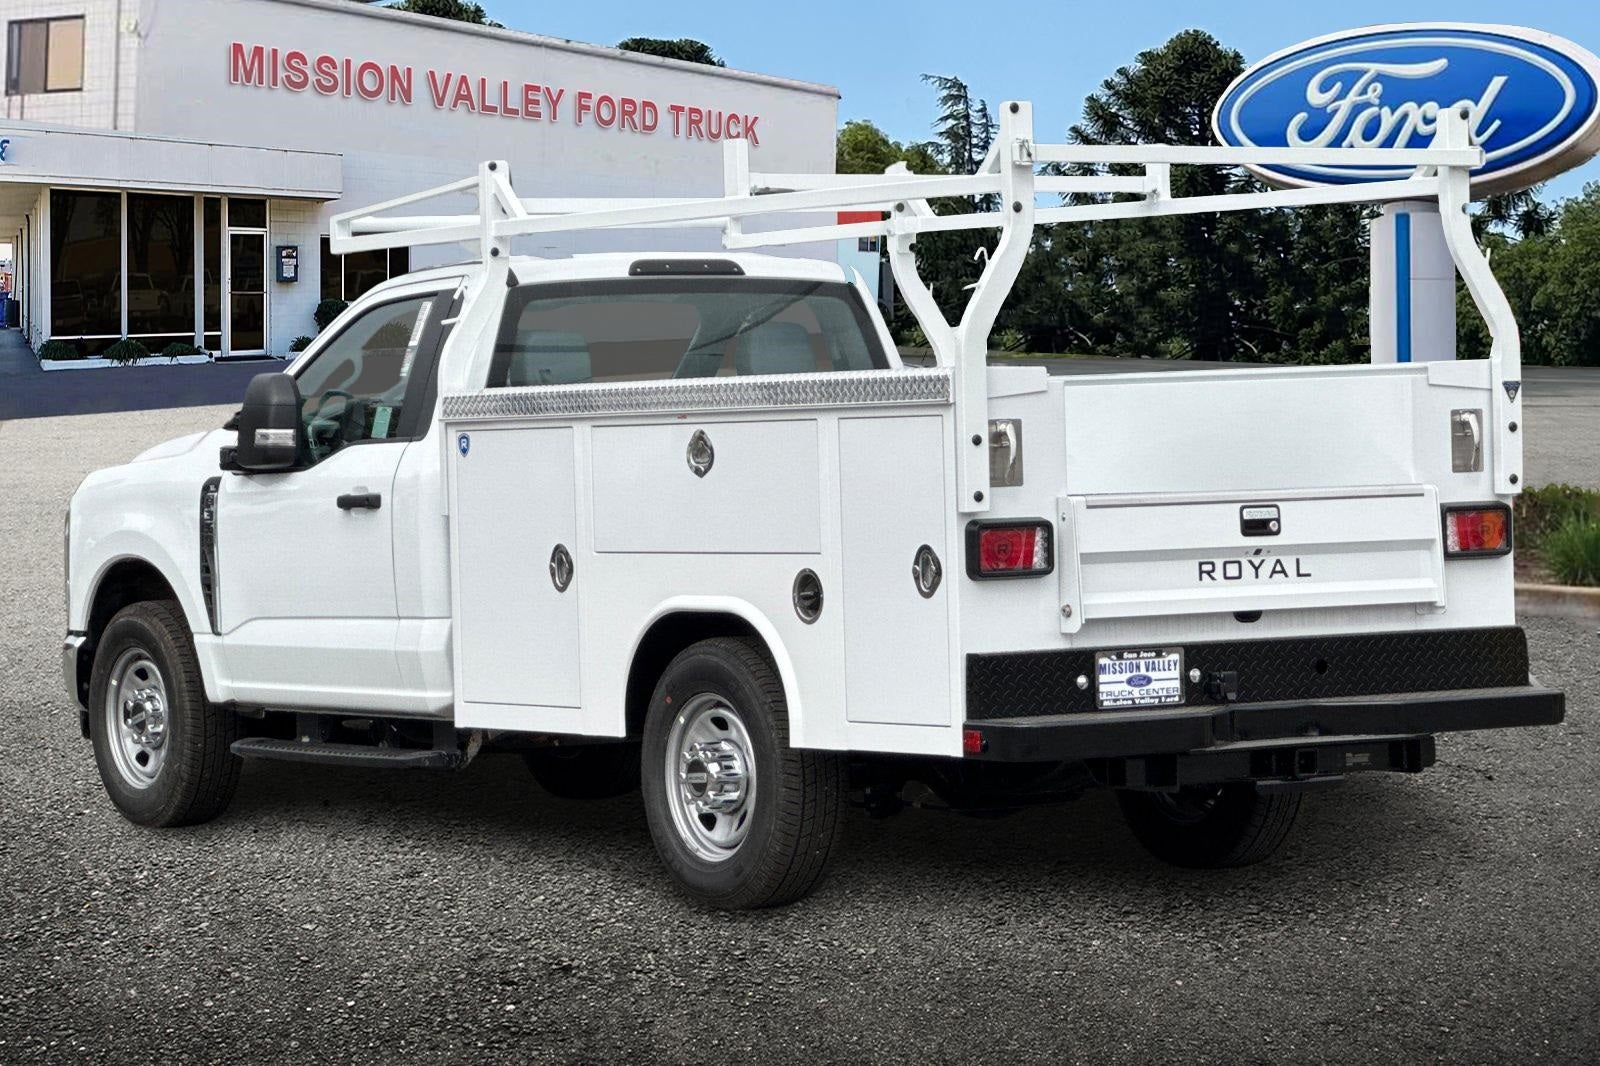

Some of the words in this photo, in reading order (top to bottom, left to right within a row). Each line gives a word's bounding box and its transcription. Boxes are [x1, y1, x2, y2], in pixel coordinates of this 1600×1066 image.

[230, 41, 414, 105] MISSION
[427, 69, 565, 122] VALLEY
[575, 90, 659, 134] FORD
[668, 103, 761, 147] TRUCK
[1286, 57, 1509, 152] Ford
[1198, 557, 1312, 582] ROYAL
[1099, 661, 1141, 675] MISSION
[1144, 659, 1178, 673] VALLEY
[1100, 689, 1134, 698] TRUCK
[1138, 686, 1179, 696] CENTER
